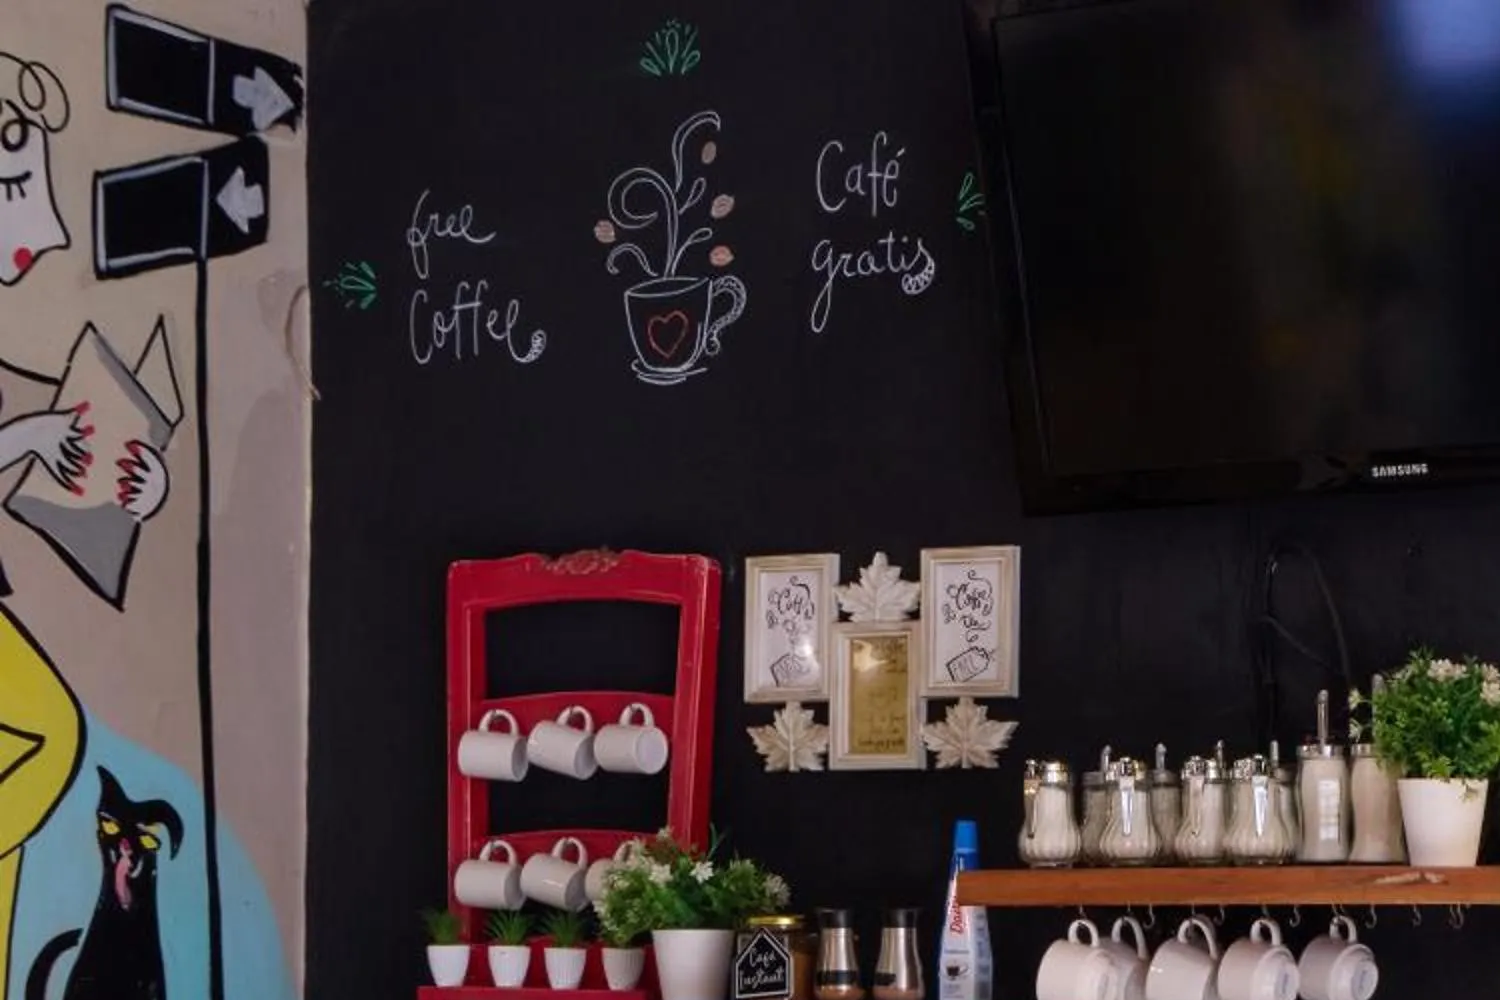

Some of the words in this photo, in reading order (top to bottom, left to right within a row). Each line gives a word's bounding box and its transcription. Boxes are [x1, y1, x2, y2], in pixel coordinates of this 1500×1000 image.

[815, 131, 906, 218] Café
[409, 280, 547, 364] Coffee
[810, 231, 936, 333] gratis
[1371, 463, 1429, 478] SAMSUNG
